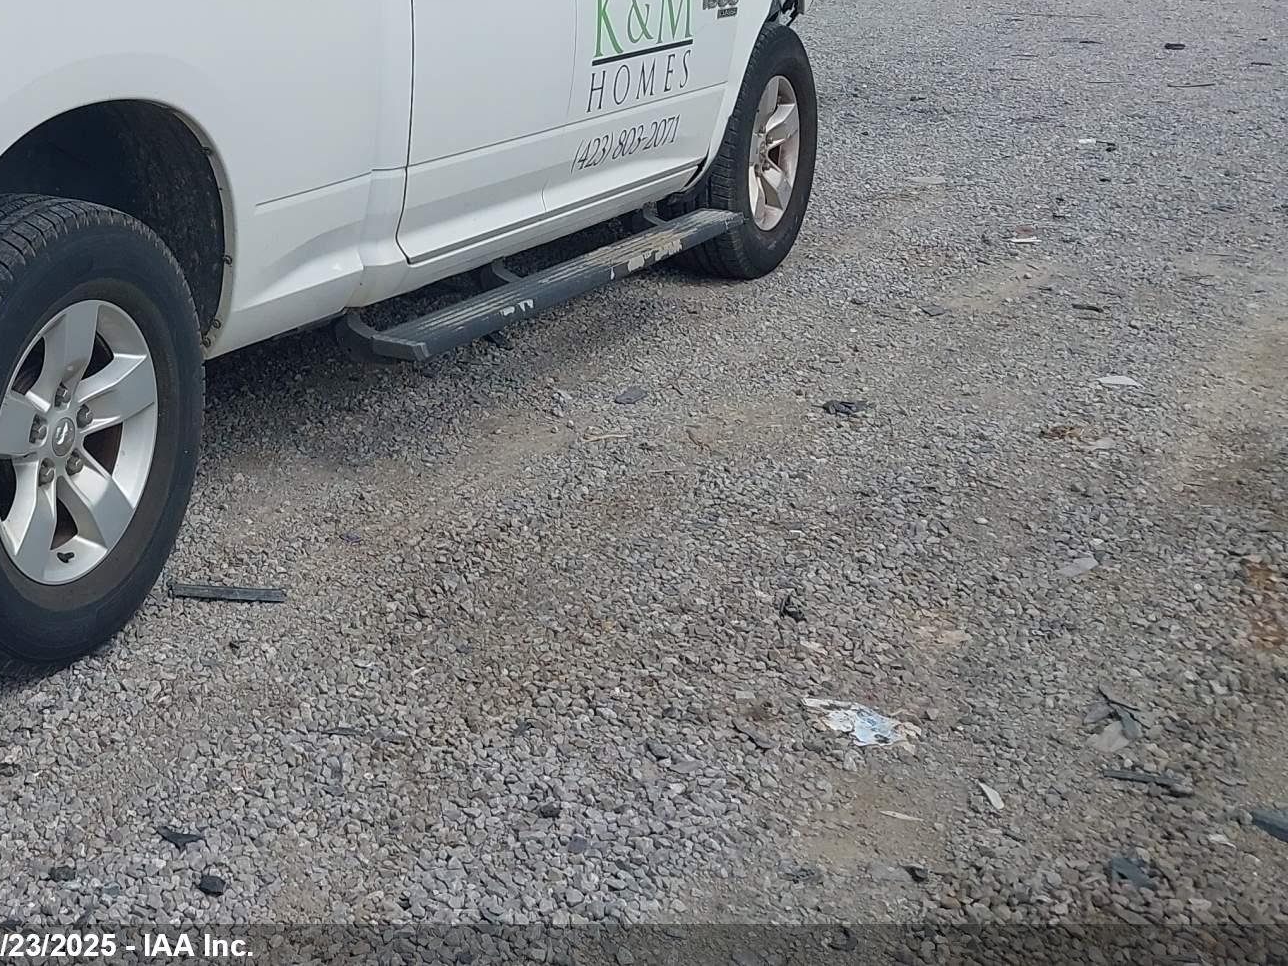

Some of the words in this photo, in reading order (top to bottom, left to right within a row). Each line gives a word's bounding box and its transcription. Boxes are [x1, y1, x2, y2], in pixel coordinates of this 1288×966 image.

[586, 48, 692, 114] HOMES
[570, 130, 614, 174] (423)
[612, 114, 681, 160] 803-2071
